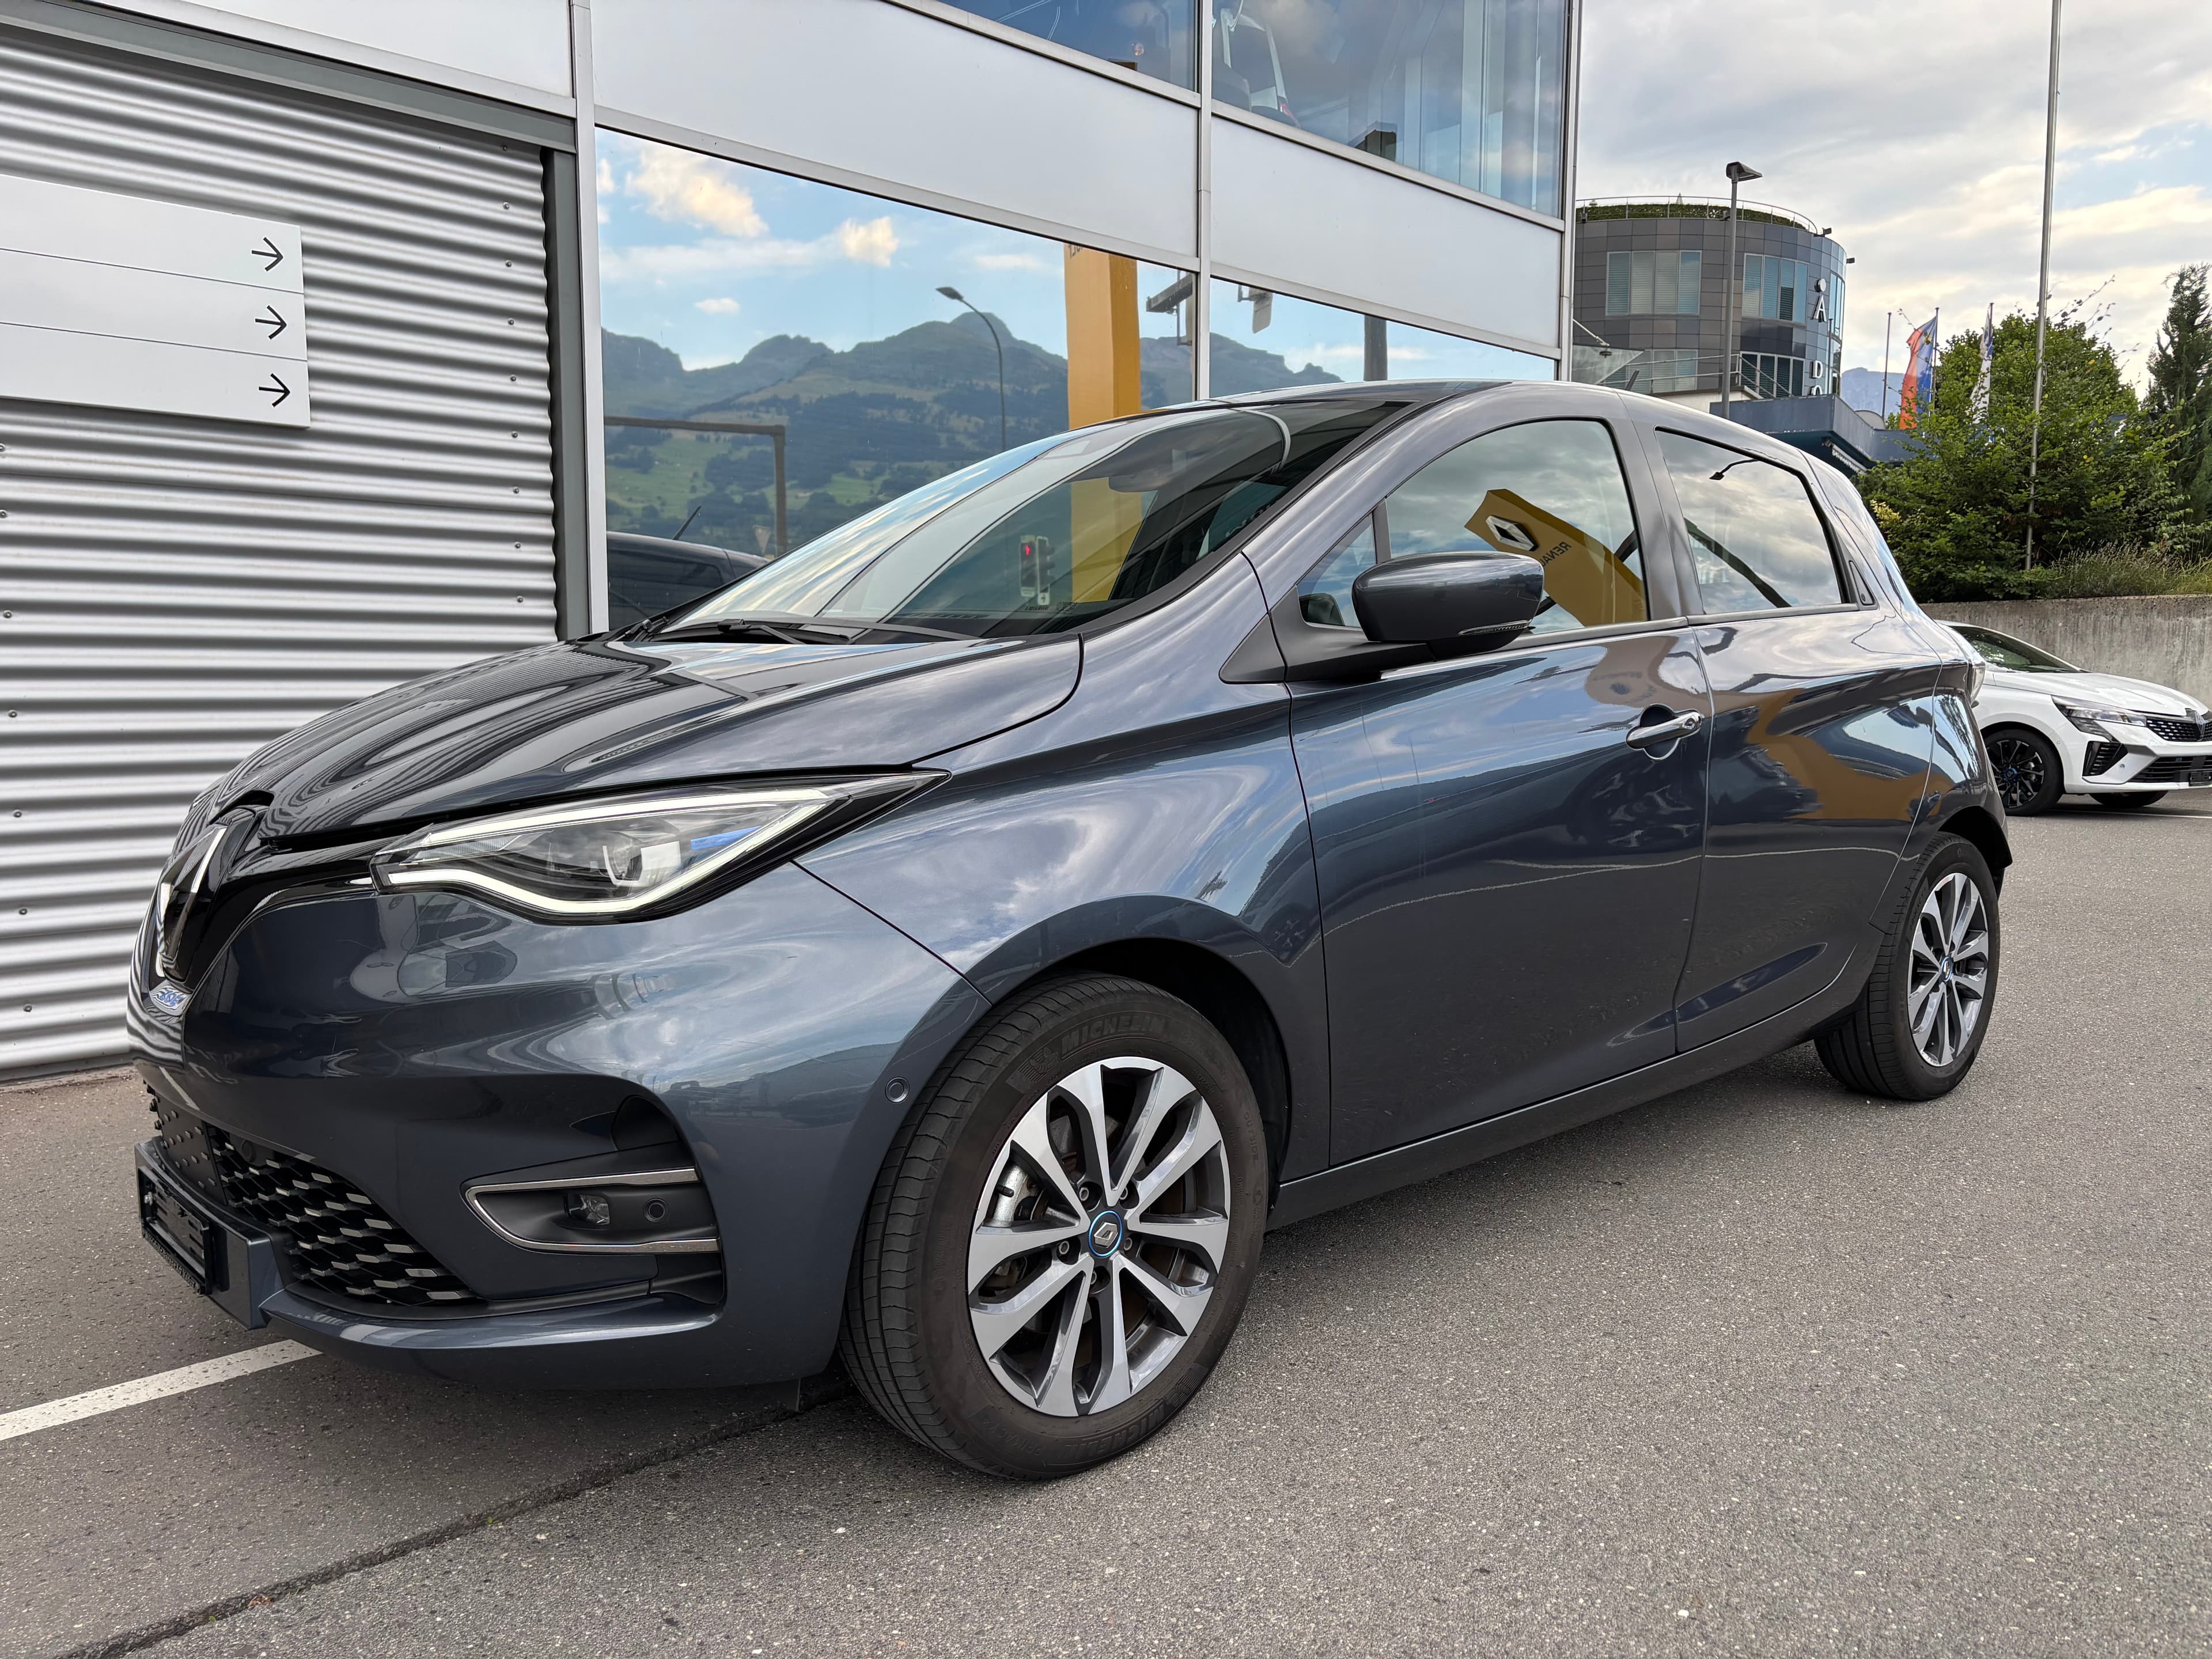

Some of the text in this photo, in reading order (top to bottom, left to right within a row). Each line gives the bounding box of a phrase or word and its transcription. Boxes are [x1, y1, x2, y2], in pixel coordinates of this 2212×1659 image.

[1062, 1016, 1167, 1055] MICHELIN
[1243, 1111, 1259, 1162] OUTSIDE
[1060, 1404, 1166, 1461] MICHELIN
